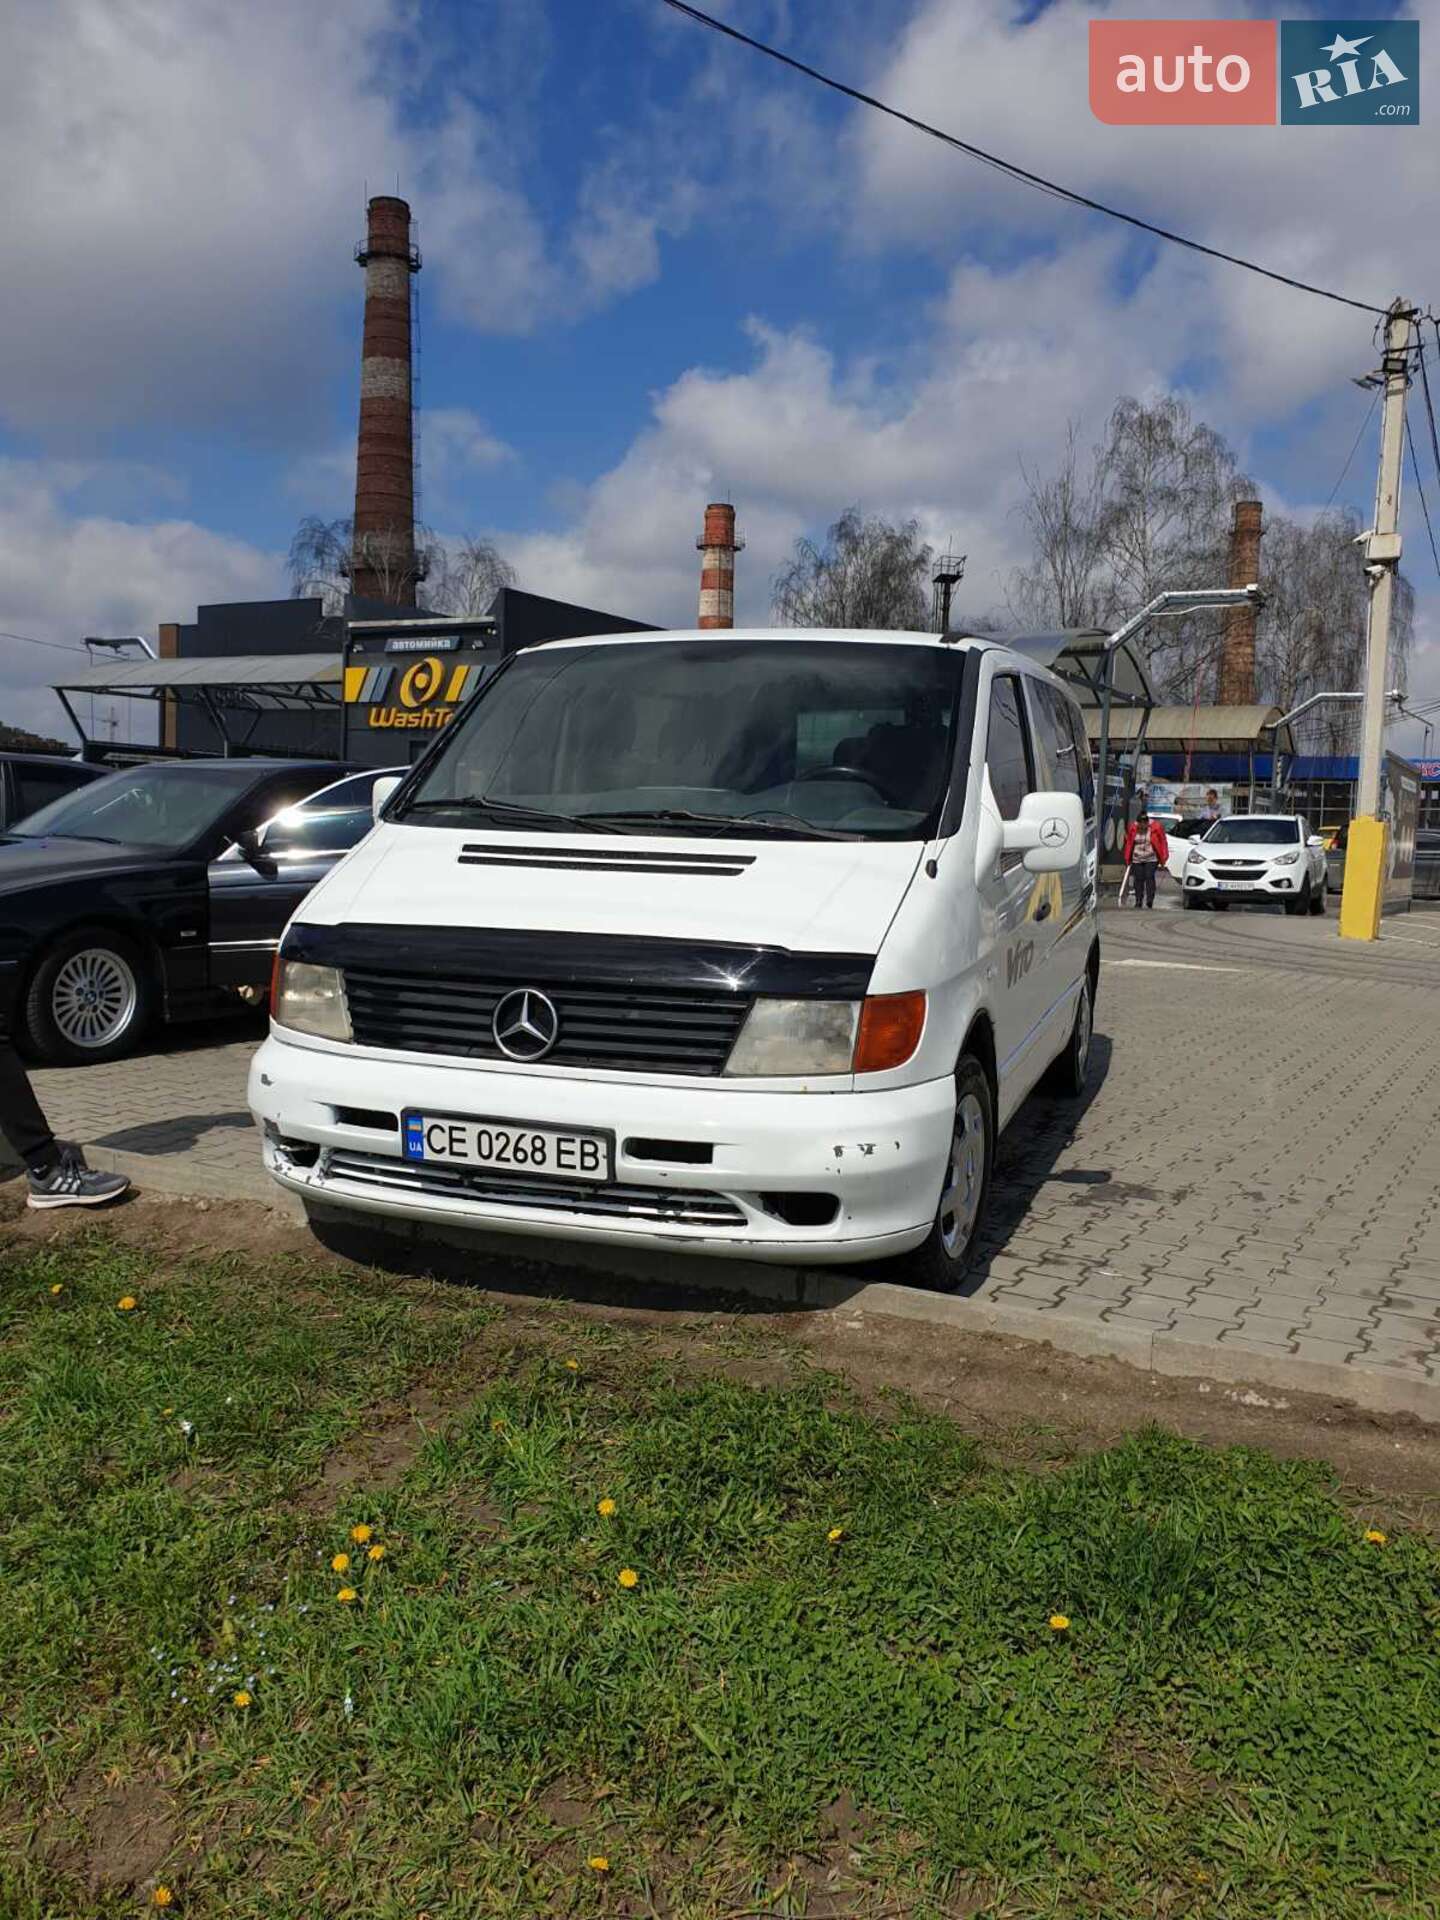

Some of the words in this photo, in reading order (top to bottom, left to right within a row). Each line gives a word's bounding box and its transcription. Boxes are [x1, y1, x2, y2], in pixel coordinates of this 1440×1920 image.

[409, 1141, 423, 1153] UA
[426, 1123, 468, 1158] CE
[477, 1129, 547, 1166] 0268
[556, 1136, 600, 1171] EB
